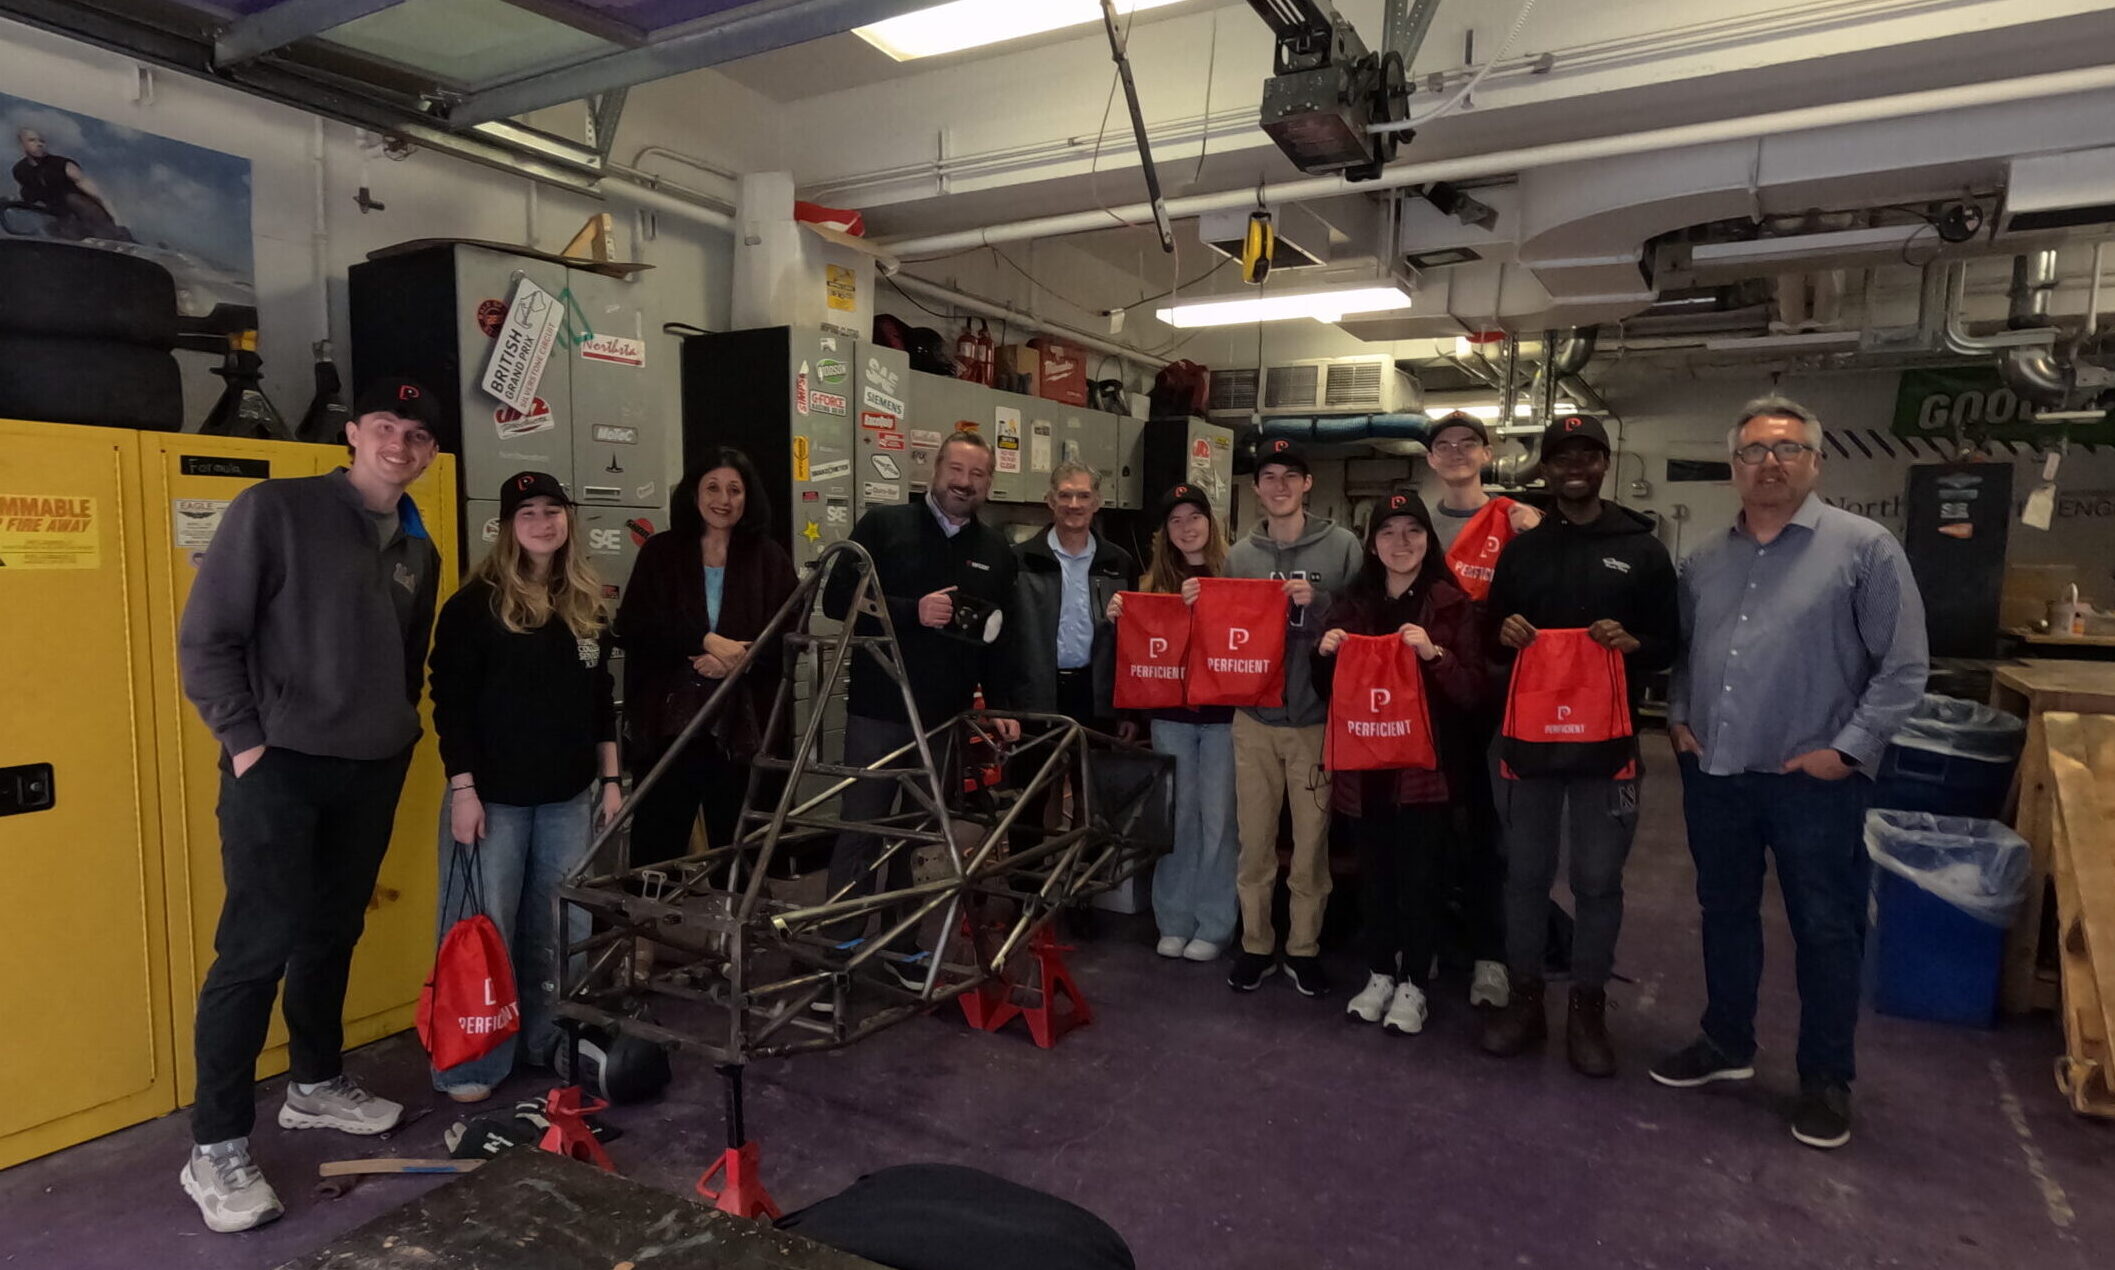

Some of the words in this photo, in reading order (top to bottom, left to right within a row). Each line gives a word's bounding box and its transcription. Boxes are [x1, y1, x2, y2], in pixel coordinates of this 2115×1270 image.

[540, 322, 556, 356] CIRCUIT
[490, 328, 522, 394] BRITISH
[505, 361, 526, 400] GRAND
[519, 334, 536, 362] PRIX
[866, 391, 903, 415] SIEMENS
[6, 518, 43, 532] FIRE
[46, 519, 92, 533] AWAY
[590, 528, 621, 550] SAE
[1130, 664, 1185, 679] PERFICIENT
[1208, 657, 1270, 674] PERFICIENT
[1347, 719, 1412, 737] PERFICIENT
[1544, 723, 1585, 735] PERFICIENT
